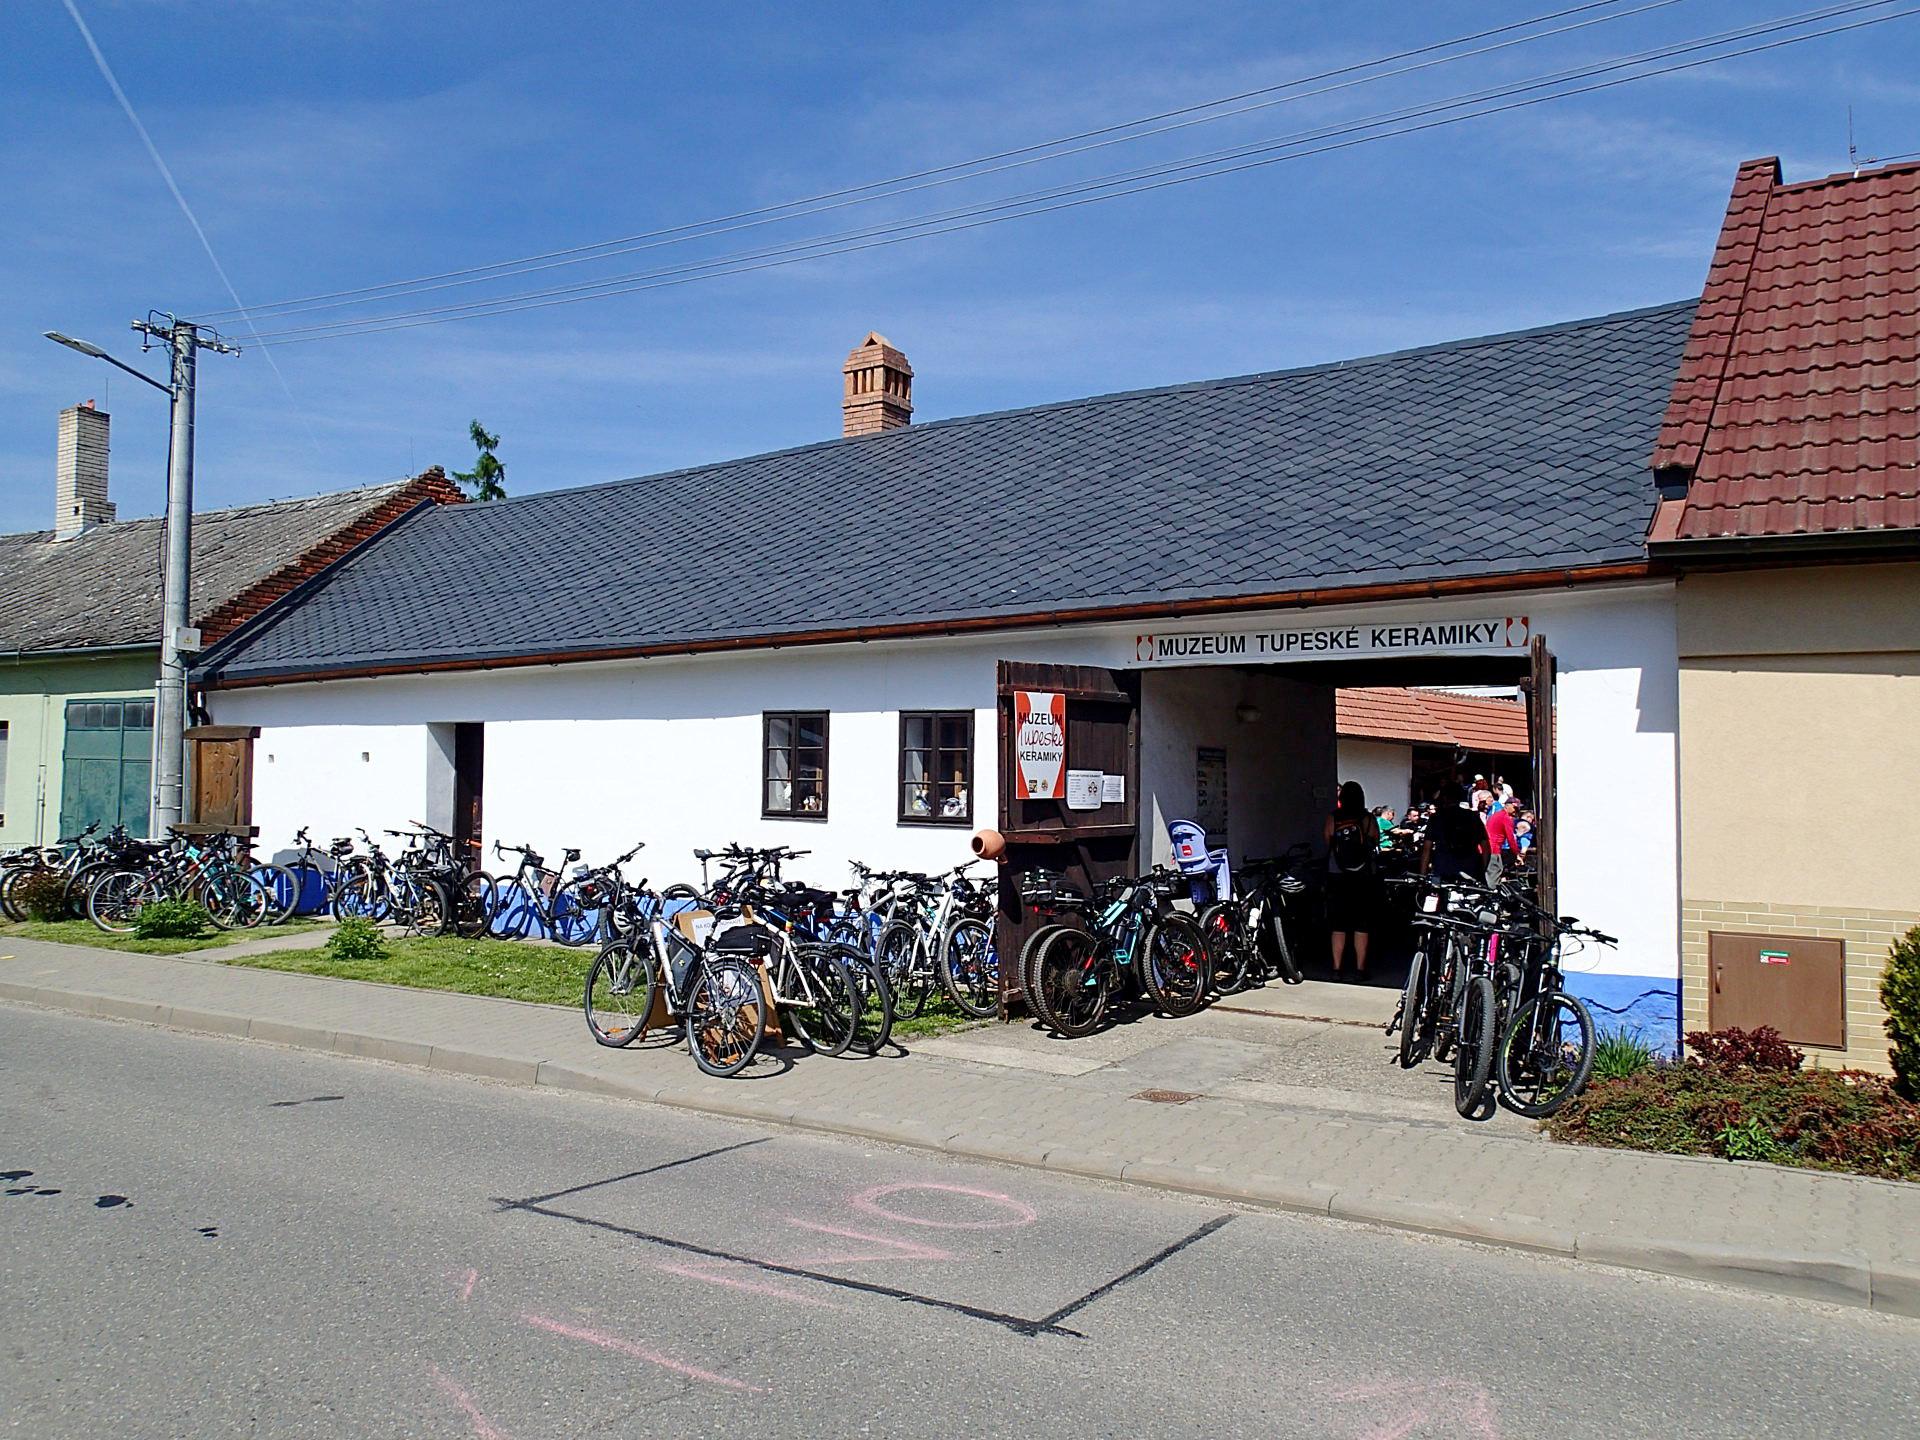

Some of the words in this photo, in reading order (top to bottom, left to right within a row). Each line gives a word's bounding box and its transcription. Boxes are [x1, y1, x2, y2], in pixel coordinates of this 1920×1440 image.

[1158, 635, 1246, 656] MUZEUM
[1256, 626, 1360, 652] TUPESKÉ
[1371, 622, 1499, 648] KERAMIKY
[1018, 711, 1063, 726] MUZEUM
[1019, 751, 1062, 762] KERAMIKY
